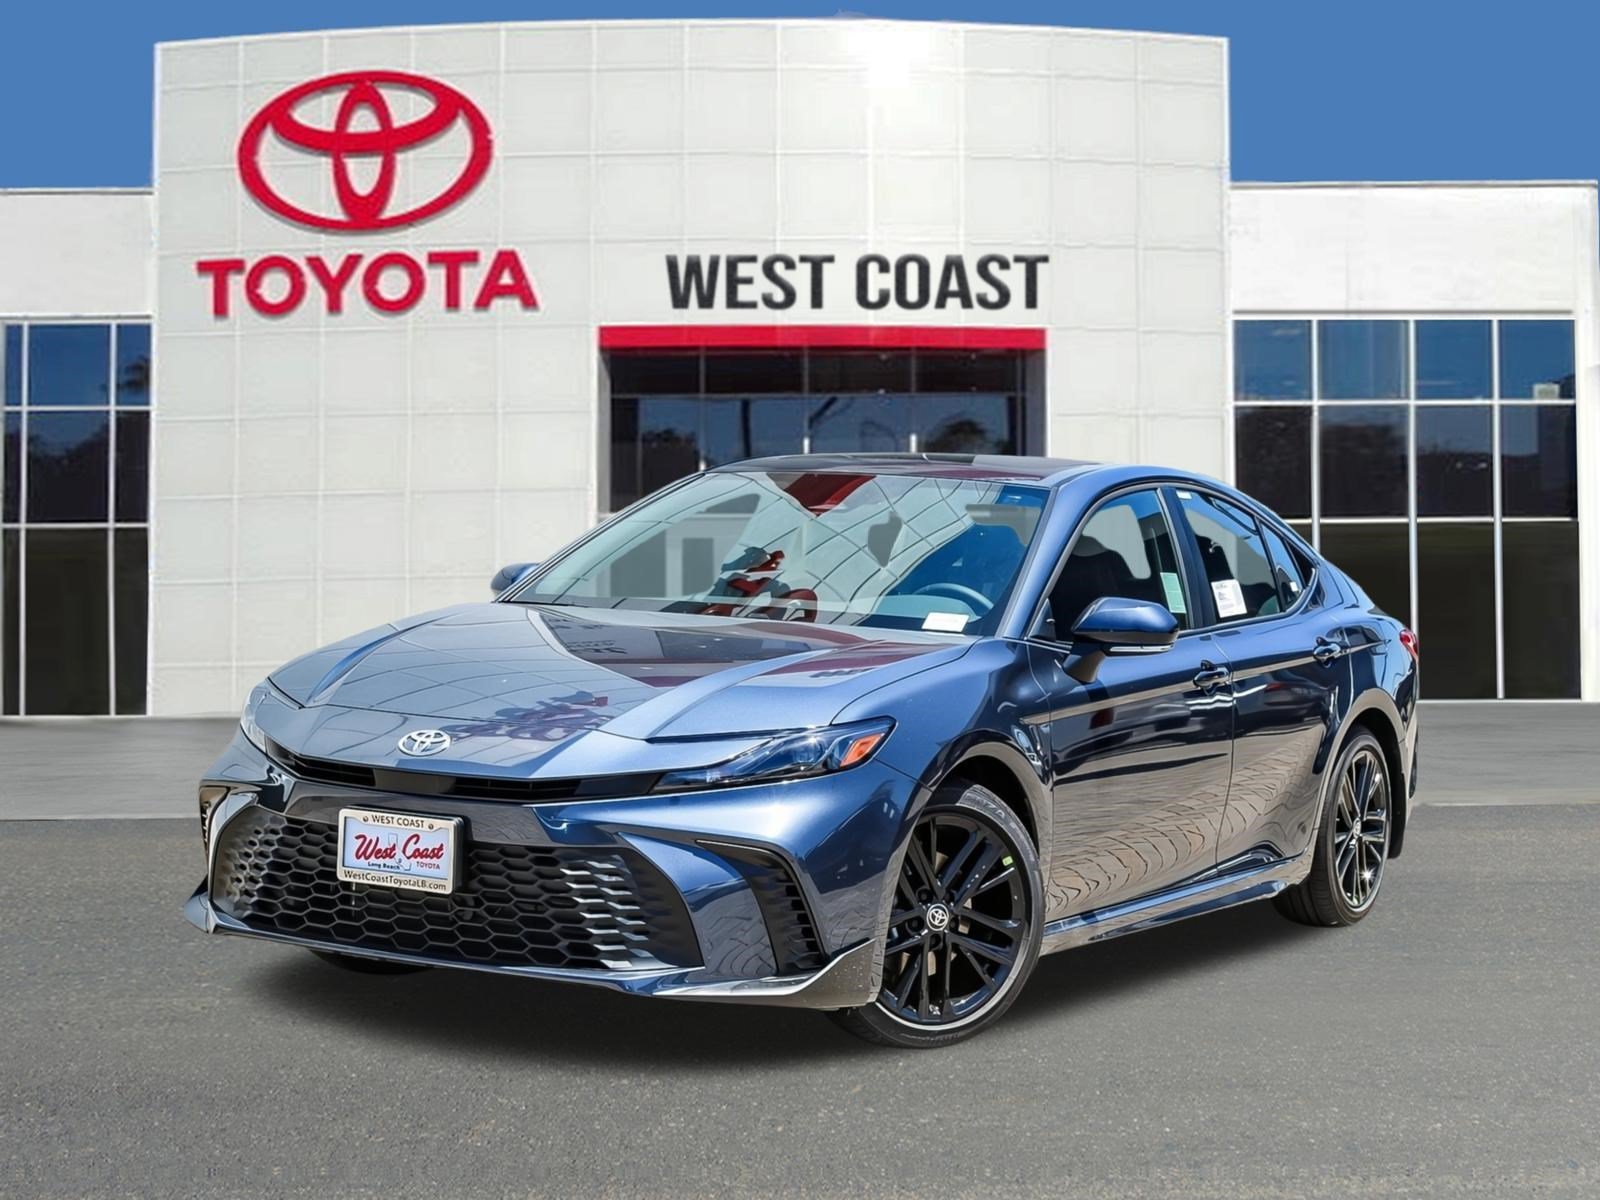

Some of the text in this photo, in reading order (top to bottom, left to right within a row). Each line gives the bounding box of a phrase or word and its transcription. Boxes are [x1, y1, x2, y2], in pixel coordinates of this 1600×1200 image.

[197, 250, 539, 317] TOYOTA
[666, 254, 1049, 310] WEST COAST
[371, 814, 425, 829] WEST COAST
[354, 833, 444, 861] West Coast
[416, 861, 441, 870] TOYOTA
[343, 869, 447, 891] WestCoastToyotaLB.com
